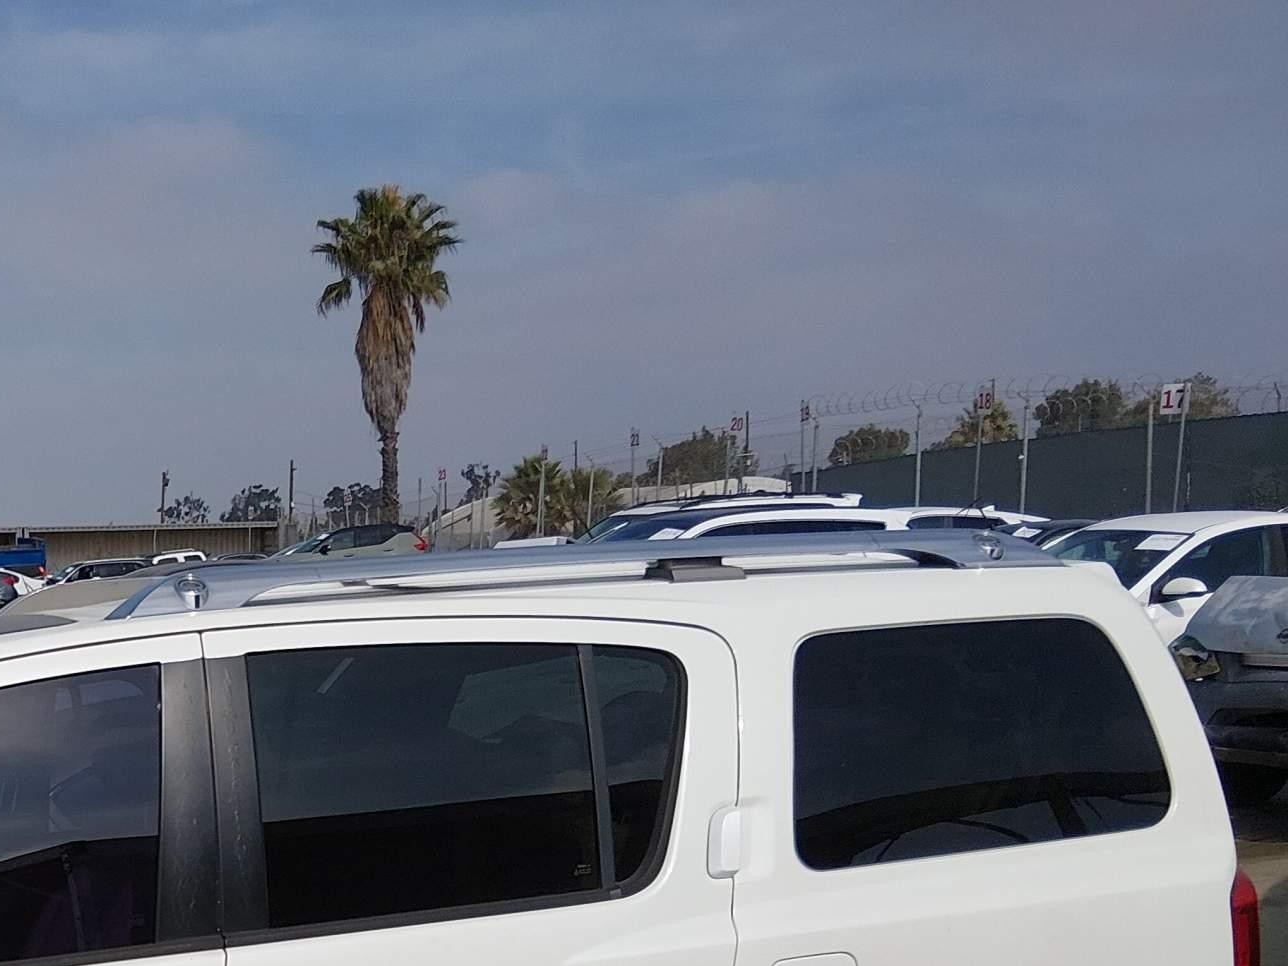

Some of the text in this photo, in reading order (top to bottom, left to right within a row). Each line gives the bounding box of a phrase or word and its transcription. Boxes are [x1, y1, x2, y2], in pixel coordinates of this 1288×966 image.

[978, 392, 992, 410] 18
[1162, 390, 1186, 409] 17
[730, 417, 744, 432] 20
[437, 469, 447, 481] 23
